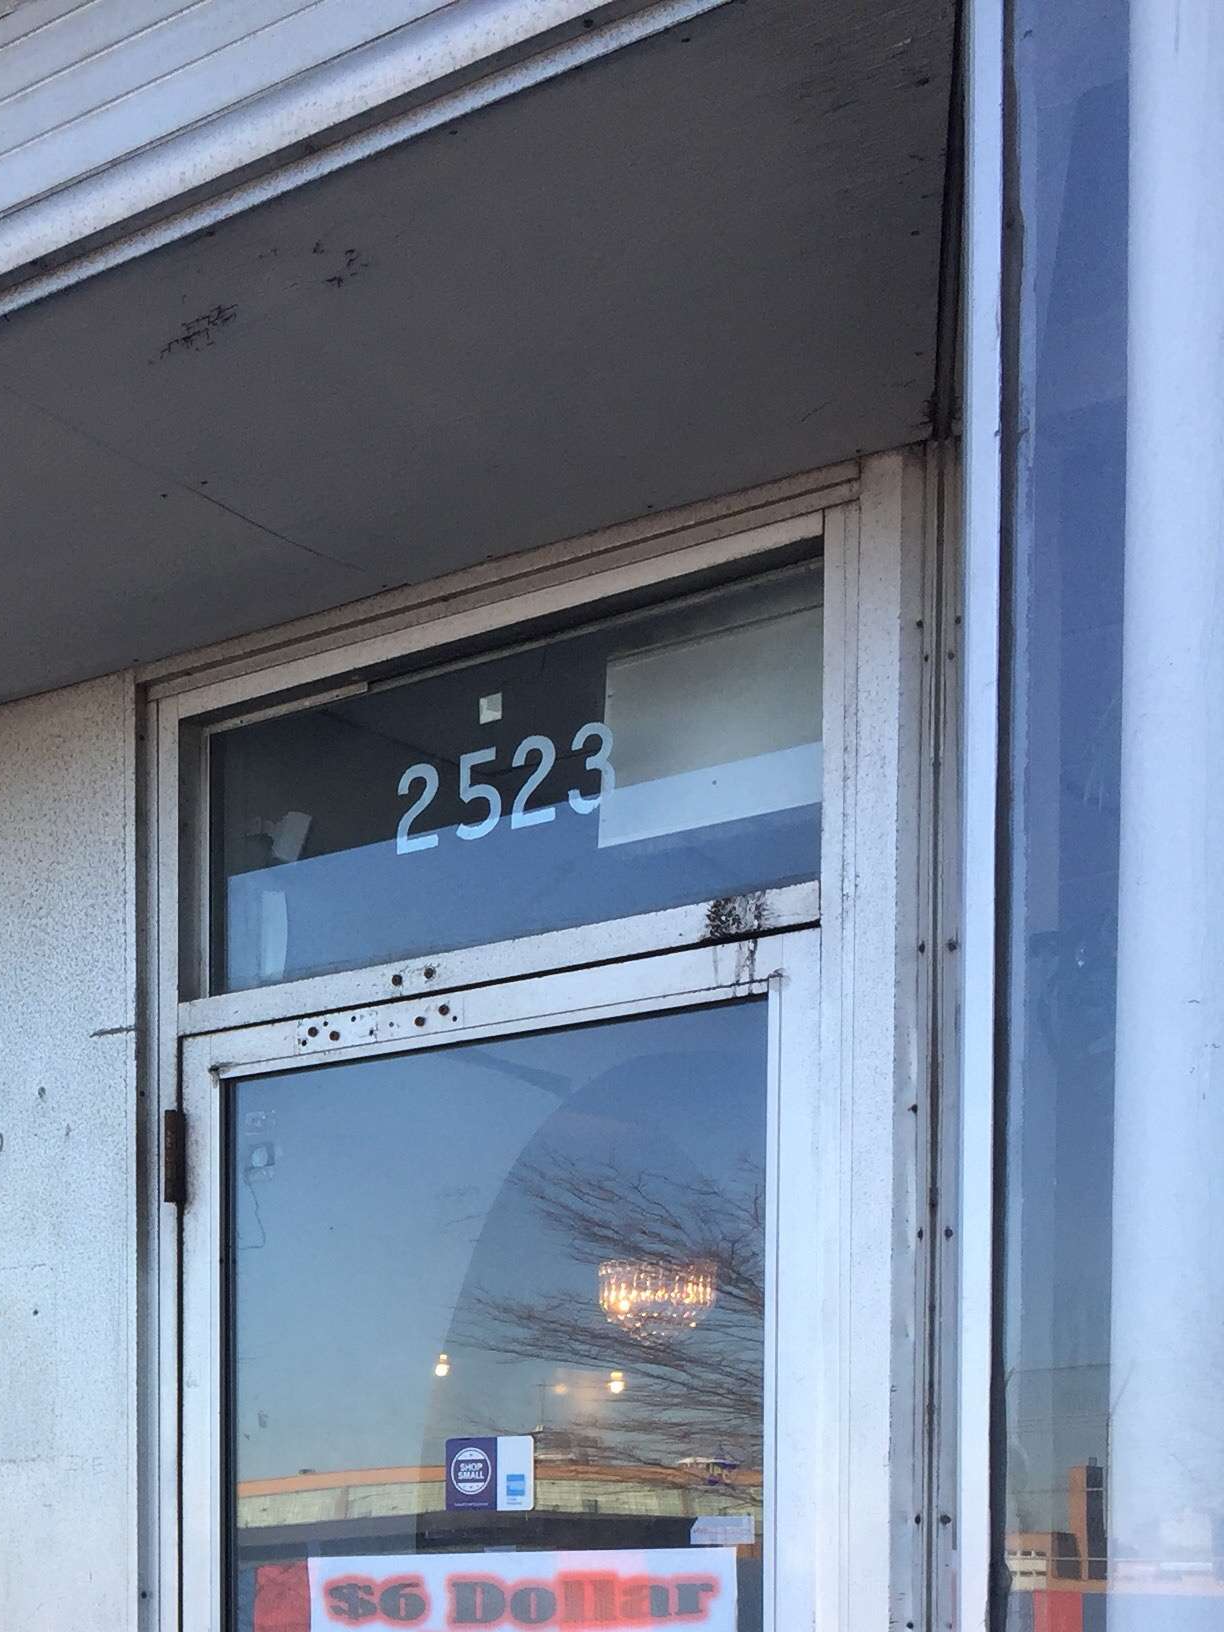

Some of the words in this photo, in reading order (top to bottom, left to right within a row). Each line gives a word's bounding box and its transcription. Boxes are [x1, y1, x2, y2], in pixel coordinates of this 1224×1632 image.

[396, 722, 616, 855] 2523
[457, 1471, 485, 1480] SMALL
[460, 1462, 483, 1472] SHOP
[327, 1580, 427, 1622] $6
[451, 1577, 714, 1624] Dollar
